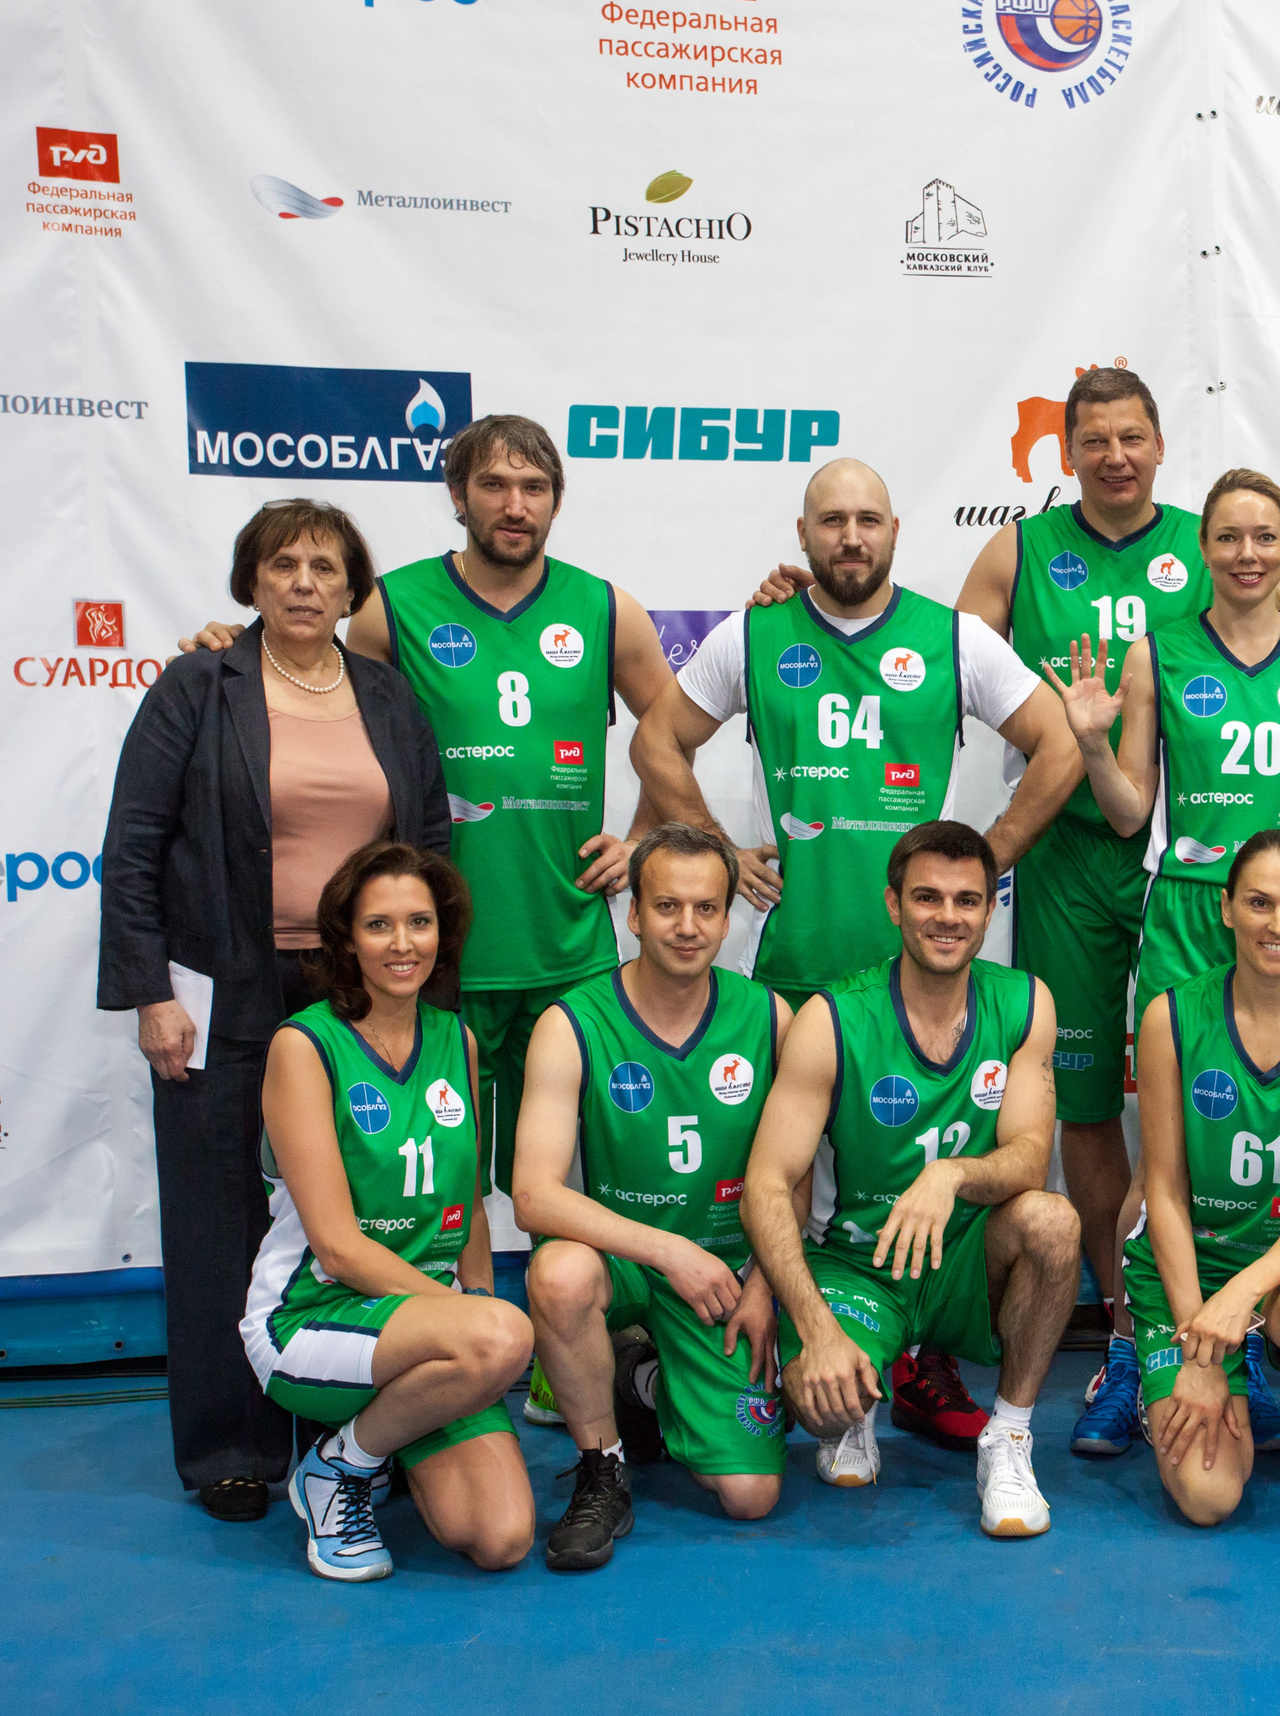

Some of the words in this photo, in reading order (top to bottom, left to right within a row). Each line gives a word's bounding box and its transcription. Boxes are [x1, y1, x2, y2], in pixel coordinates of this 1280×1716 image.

[600, 2, 778, 35] Федеральная
[598, 36, 783, 67] пассажирская
[961, 0, 1038, 109] РОССИЙСК
[1061, 0, 1133, 109] АСКЕТБОЛА
[626, 69, 759, 96] компания
[27, 181, 135, 203] Федеральная
[356, 189, 512, 214] Металлоинвест
[26, 202, 137, 222] пассажирская
[42, 221, 122, 238] компания
[622, 247, 678, 266] Jewellery
[681, 249, 720, 264] House
[906, 252, 989, 263] МОСКОВСКИЙ
[906, 263, 962, 272] КАВКАЗСКИЙ
[967, 265, 989, 273] КЛУБ
[566, 403, 841, 463] СИБУР
[1091, 595, 1147, 642] 19
[13, 656, 167, 690] СУАРДО
[497, 670, 532, 727] 8
[818, 692, 884, 749] 64
[446, 745, 515, 760] астерос
[878, 796, 926, 805] пассажирская
[879, 787, 925, 796] Федеральная
[1190, 792, 1254, 806] астерос
[1056, 1027, 1093, 1040] ерос
[872, 1096, 916, 1105] МОСОБЛГАЗ
[667, 1115, 703, 1174] 5
[398, 1135, 435, 1197] 11
[615, 1188, 687, 1207] астерос
[830, 1302, 880, 1333] БУР
